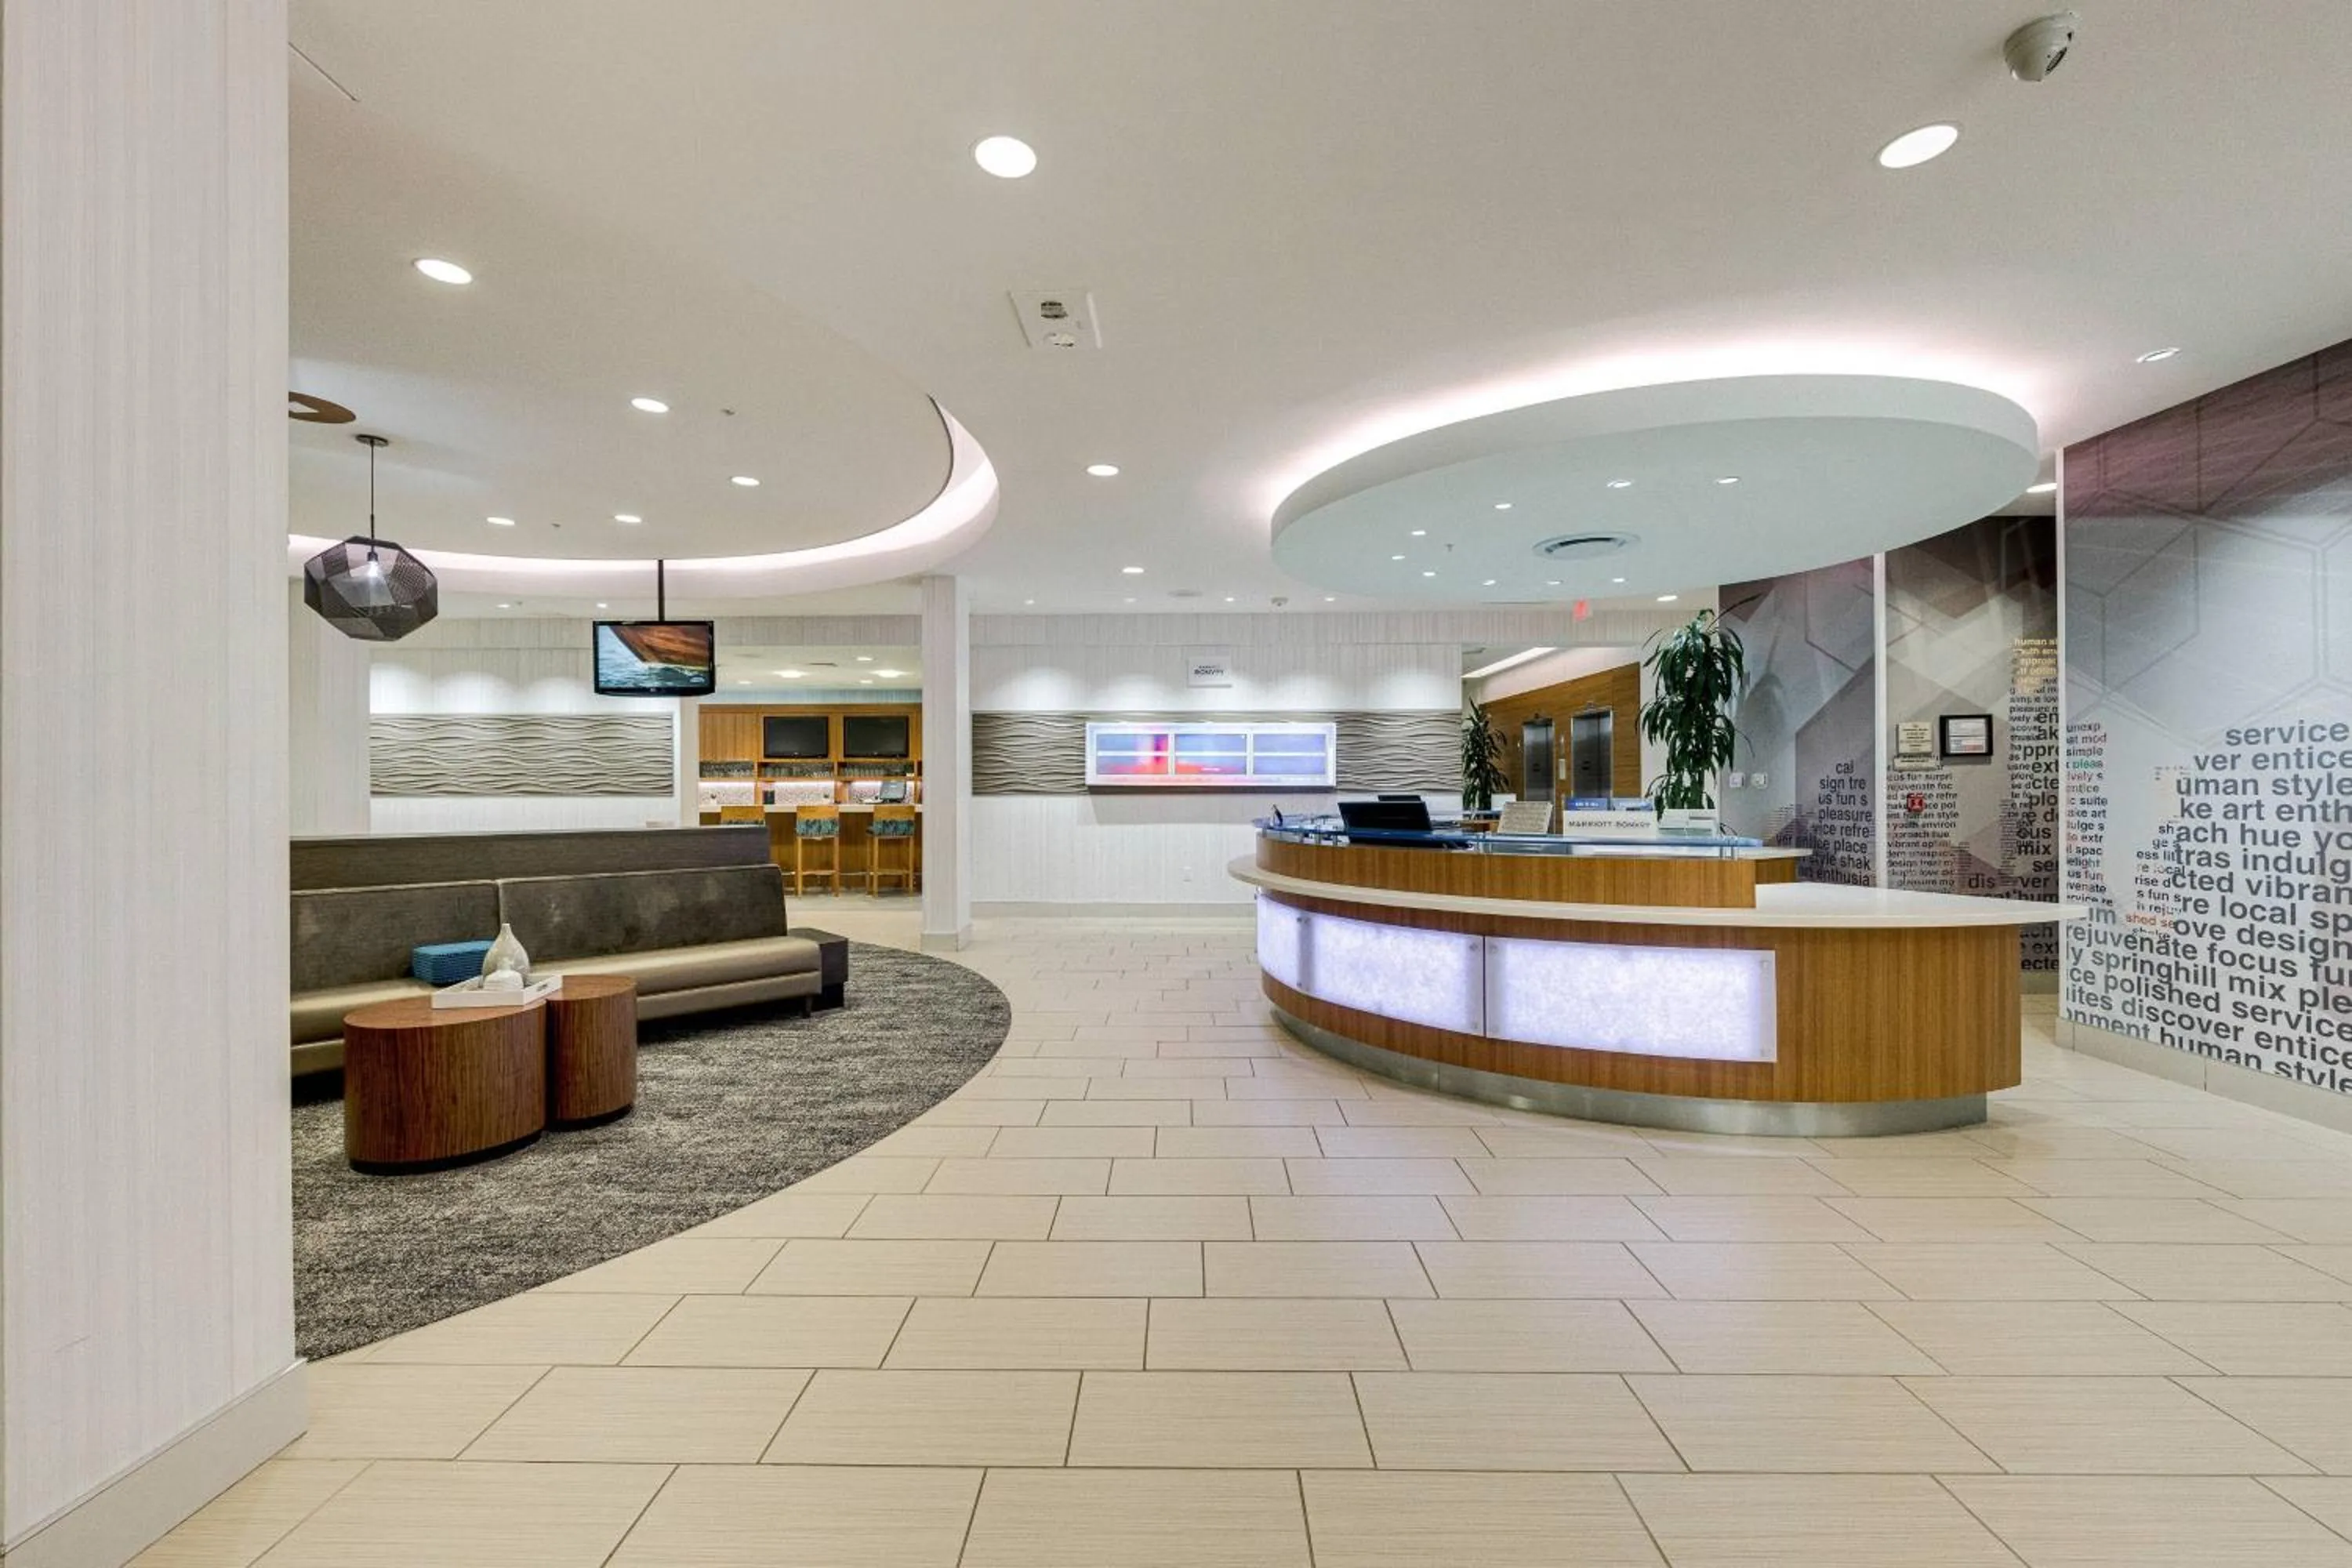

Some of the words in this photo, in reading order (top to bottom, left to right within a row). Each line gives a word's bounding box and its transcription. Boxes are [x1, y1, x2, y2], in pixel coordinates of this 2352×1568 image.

[2225, 719, 2350, 746] service
[2066, 746, 2103, 757] simple
[2193, 753, 2241, 771] ver
[2252, 746, 2352, 771] entice
[1819, 775, 1845, 793] sign
[2176, 776, 2259, 797] uman
[2271, 771, 2352, 802] style
[1818, 806, 1872, 822] pleasure
[2079, 796, 2108, 806] suite
[2180, 797, 2213, 819] ke
[2223, 799, 2265, 821] art
[2275, 798, 2352, 822] enth
[1834, 838, 1867, 854] place
[2176, 821, 2227, 844] ach
[2240, 822, 2302, 848] hue
[2075, 846, 2103, 856] spac
[2175, 844, 2231, 869] tras
[2242, 848, 2352, 884] indulg
[2135, 874, 2158, 887] rise
[2171, 870, 2234, 894] cted
[2245, 874, 2352, 905] vibran
[2148, 887, 2169, 902] fun
[2182, 896, 2210, 915] re
[2220, 895, 2296, 926] local
[2310, 910, 2352, 938] sp
[2173, 918, 2227, 941] ove
[2237, 924, 2352, 962] design
[2066, 923, 2198, 960] rejuvenate
[2206, 942, 2298, 978] focus
[2309, 956, 2352, 986] fu
[2092, 949, 2216, 989] springhill
[2229, 973, 2287, 1002] mix
[2299, 985, 2352, 1014] ple
[2104, 973, 2221, 1014] polished
[2232, 1000, 2352, 1042] service
[2122, 996, 2245, 1042] discover
[2254, 1029, 2352, 1070] entice
[2160, 1026, 2263, 1071] human
